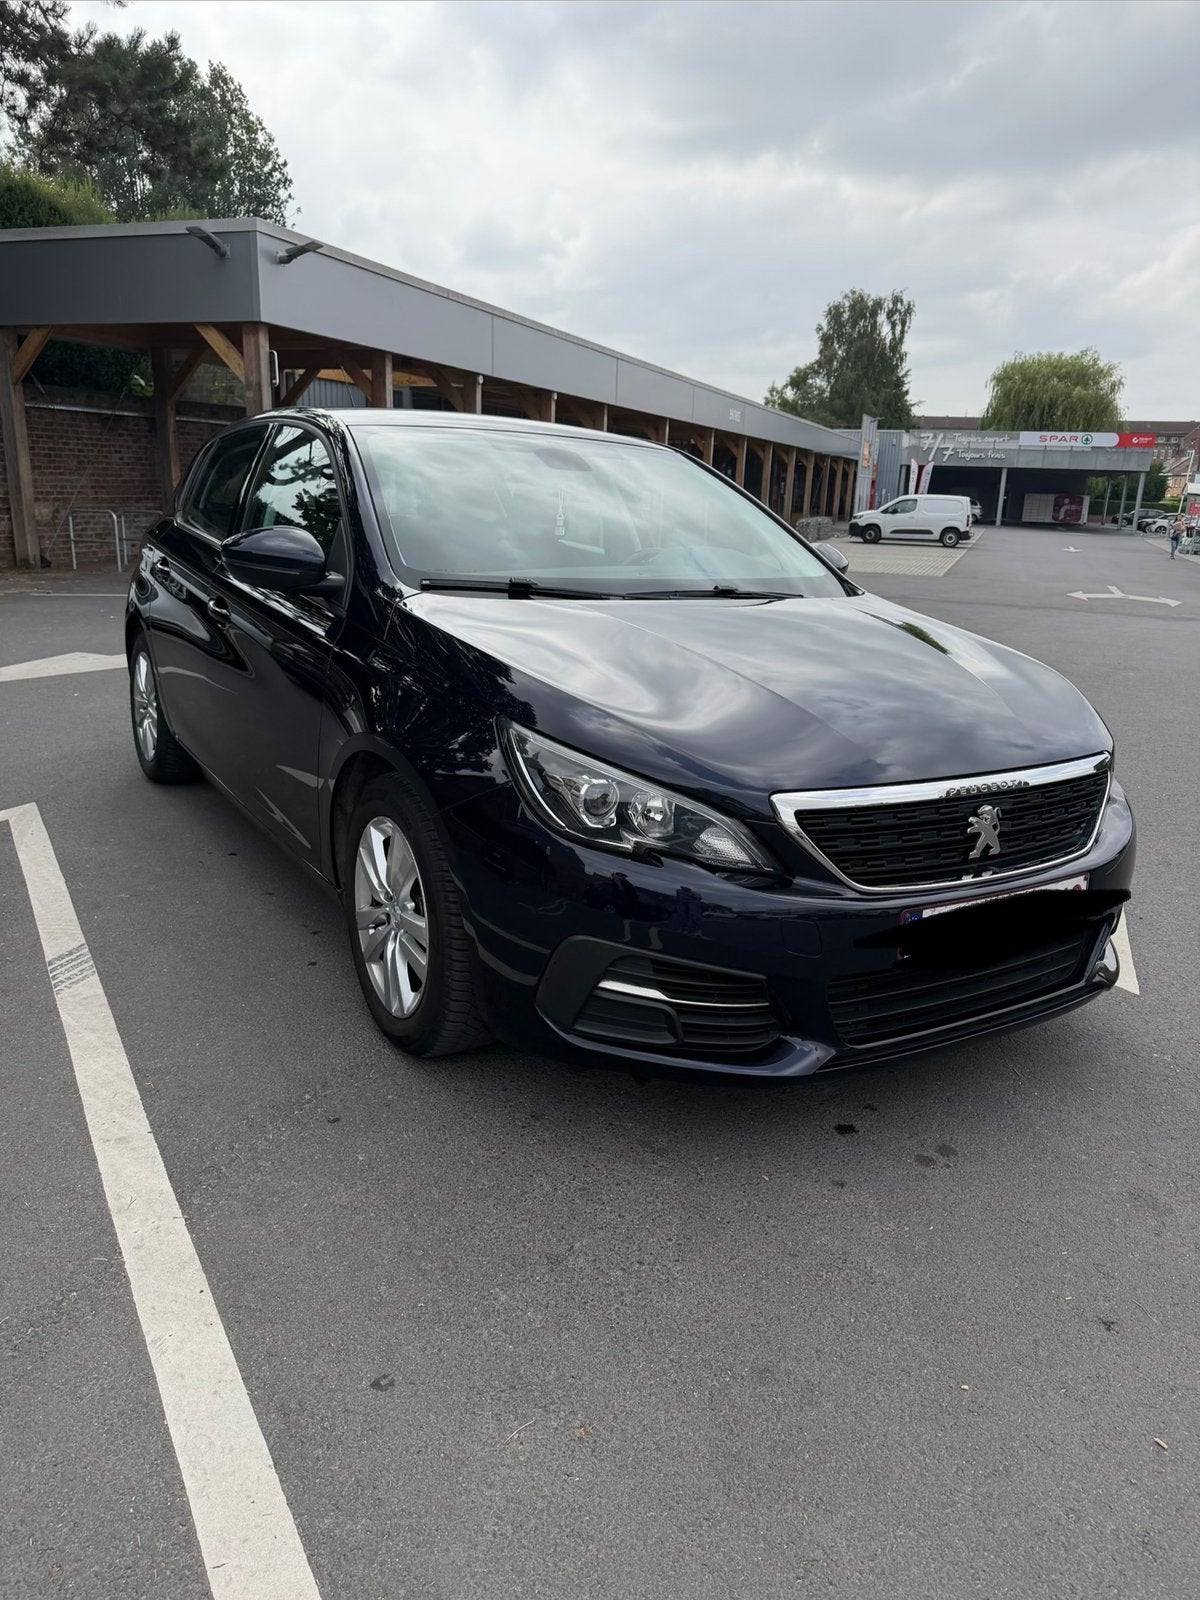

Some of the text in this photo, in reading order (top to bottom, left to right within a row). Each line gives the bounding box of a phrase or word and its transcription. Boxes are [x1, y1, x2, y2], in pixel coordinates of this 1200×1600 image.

[1039, 435, 1079, 443] SPAR
[920, 432, 954, 462] 7/7
[956, 449, 1006, 461] Toujours frais
[949, 780, 1016, 796] PEUGEOT
